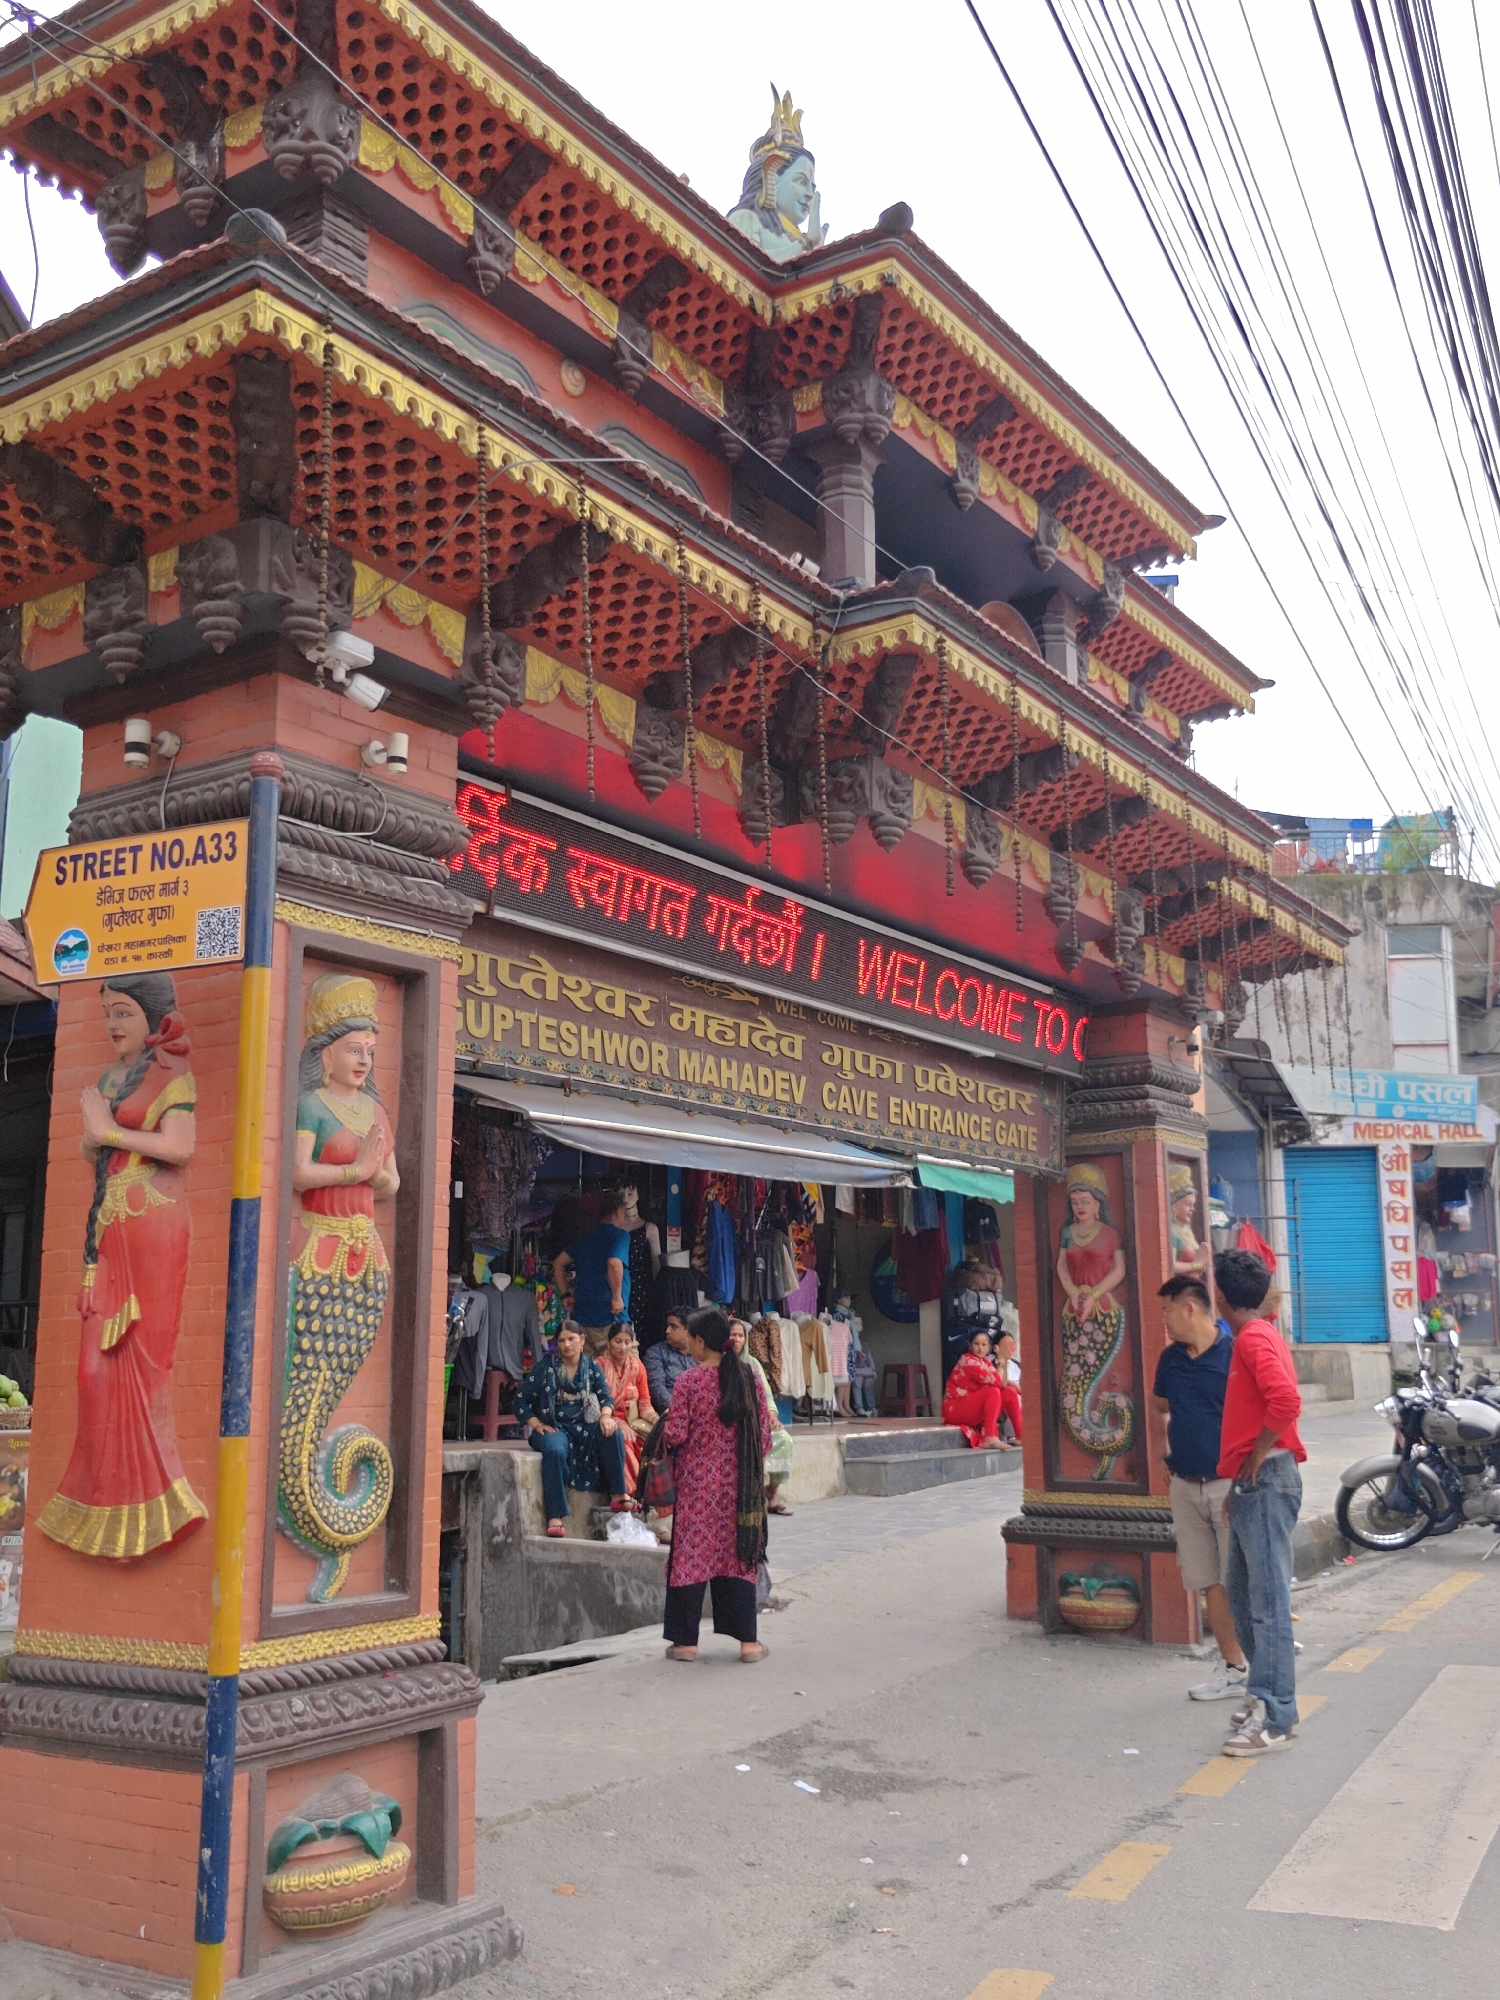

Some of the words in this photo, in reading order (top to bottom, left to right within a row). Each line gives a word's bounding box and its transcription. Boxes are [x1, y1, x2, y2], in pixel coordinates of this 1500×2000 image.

[55, 844, 143, 886] STREET
[150, 831, 237, 872] NO.A33
[96, 885, 125, 906] डेभिज
[128, 884, 156, 901] फल्स
[159, 876, 180, 897] मार्ग
[183, 880, 189, 896] ३
[566, 847, 697, 939] स्वागत
[102, 907, 145, 932] (गुप्तेश्वर
[147, 904, 175, 927] गुफा)
[124, 934, 187, 950] महानगरपालिका
[147, 948, 173, 961] कास्की
[858, 938, 1027, 1043] WELCOME
[1033, 1000, 1069, 1054] TO
[458, 945, 658, 1027] गुप्तेश्वर
[669, 1000, 806, 1062] महादेव
[821, 1039, 905, 1086] गुफा
[913, 1063, 1038, 1117] प्रवेशद्वार
[817, 1010, 858, 1034] COME
[678, 1048, 807, 1105] MAHADEV
[822, 1082, 879, 1121] CAVE
[889, 1096, 993, 1143] ENTRANCE
[995, 1122, 1038, 1152] GATE
[1398, 1081, 1473, 1105] पसल
[1353, 1121, 1434, 1140] MEDICAL
[1438, 1122, 1483, 1139] HALL
